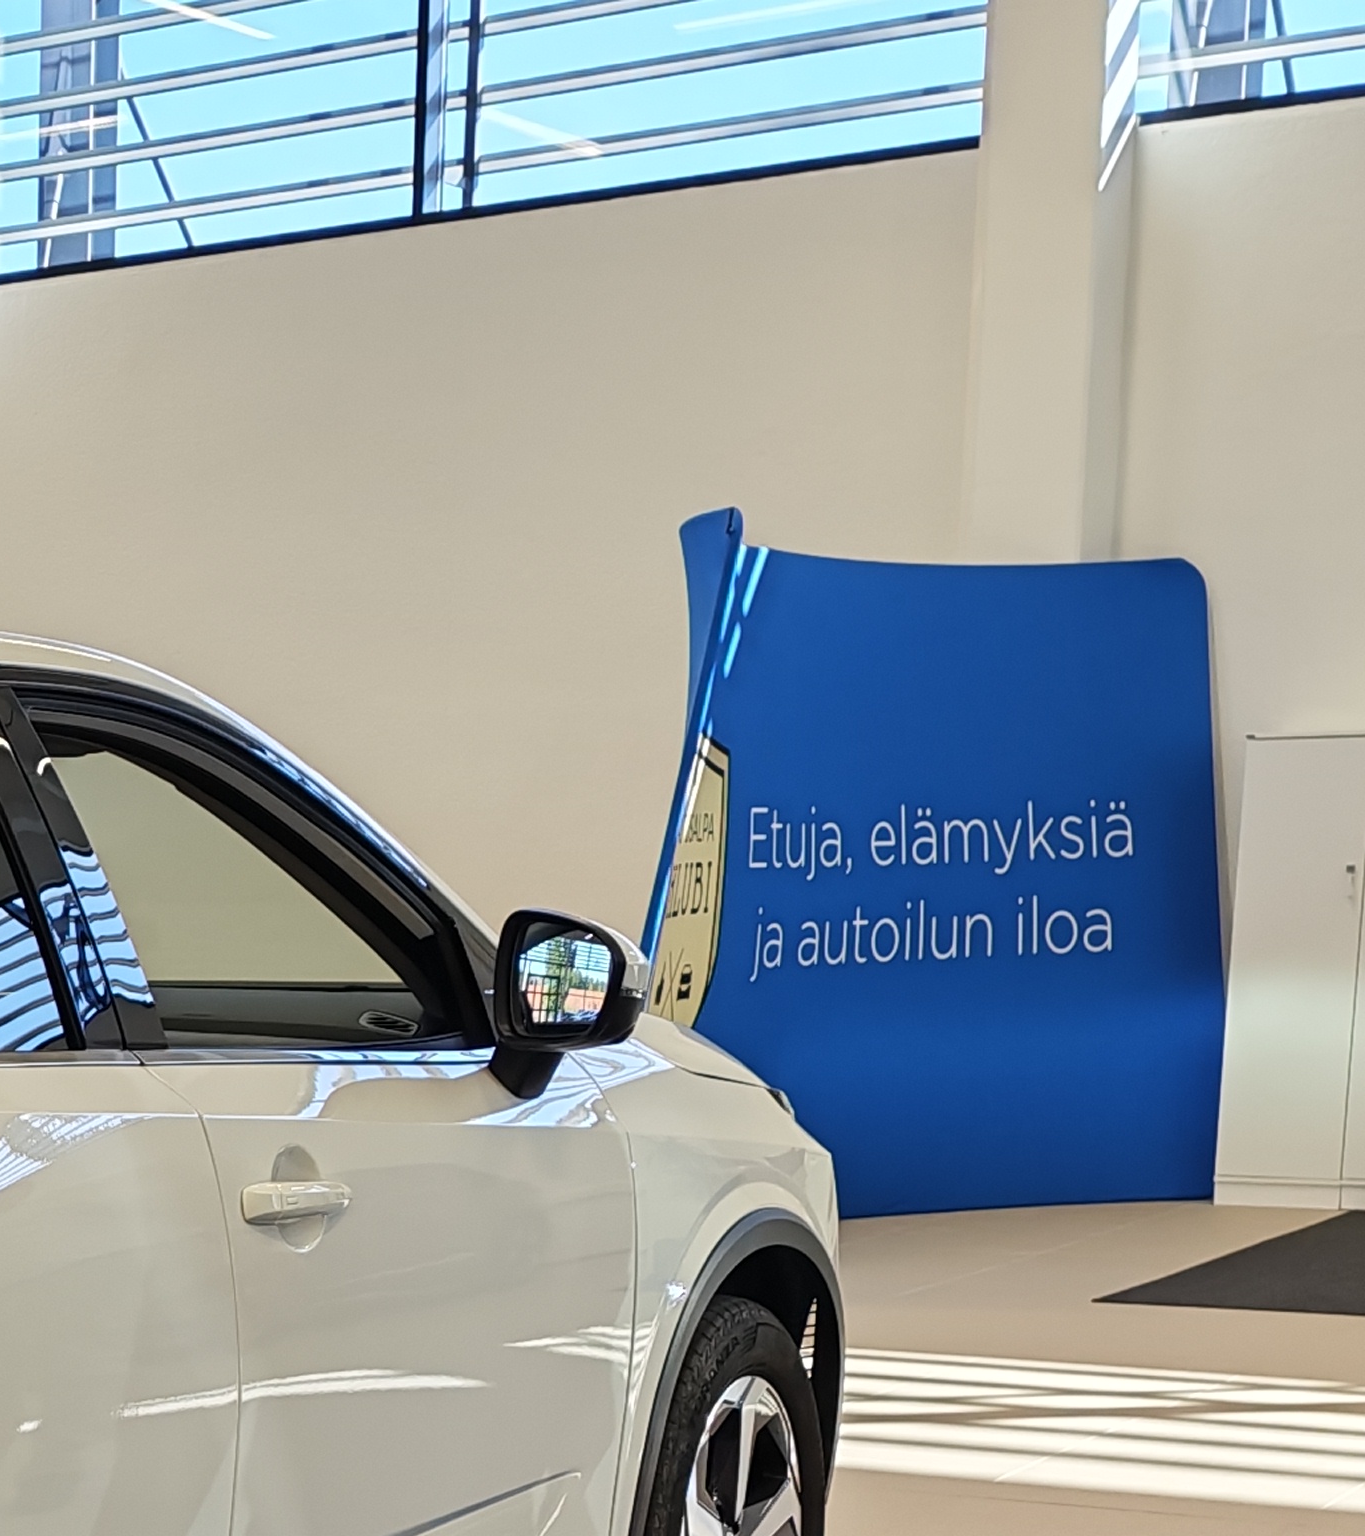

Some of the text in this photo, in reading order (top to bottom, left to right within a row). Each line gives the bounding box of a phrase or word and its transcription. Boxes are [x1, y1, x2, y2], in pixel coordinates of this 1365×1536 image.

[748, 799, 1134, 882] Etuja, elämyksiä
[749, 894, 1114, 983] ja autoilun iloa
